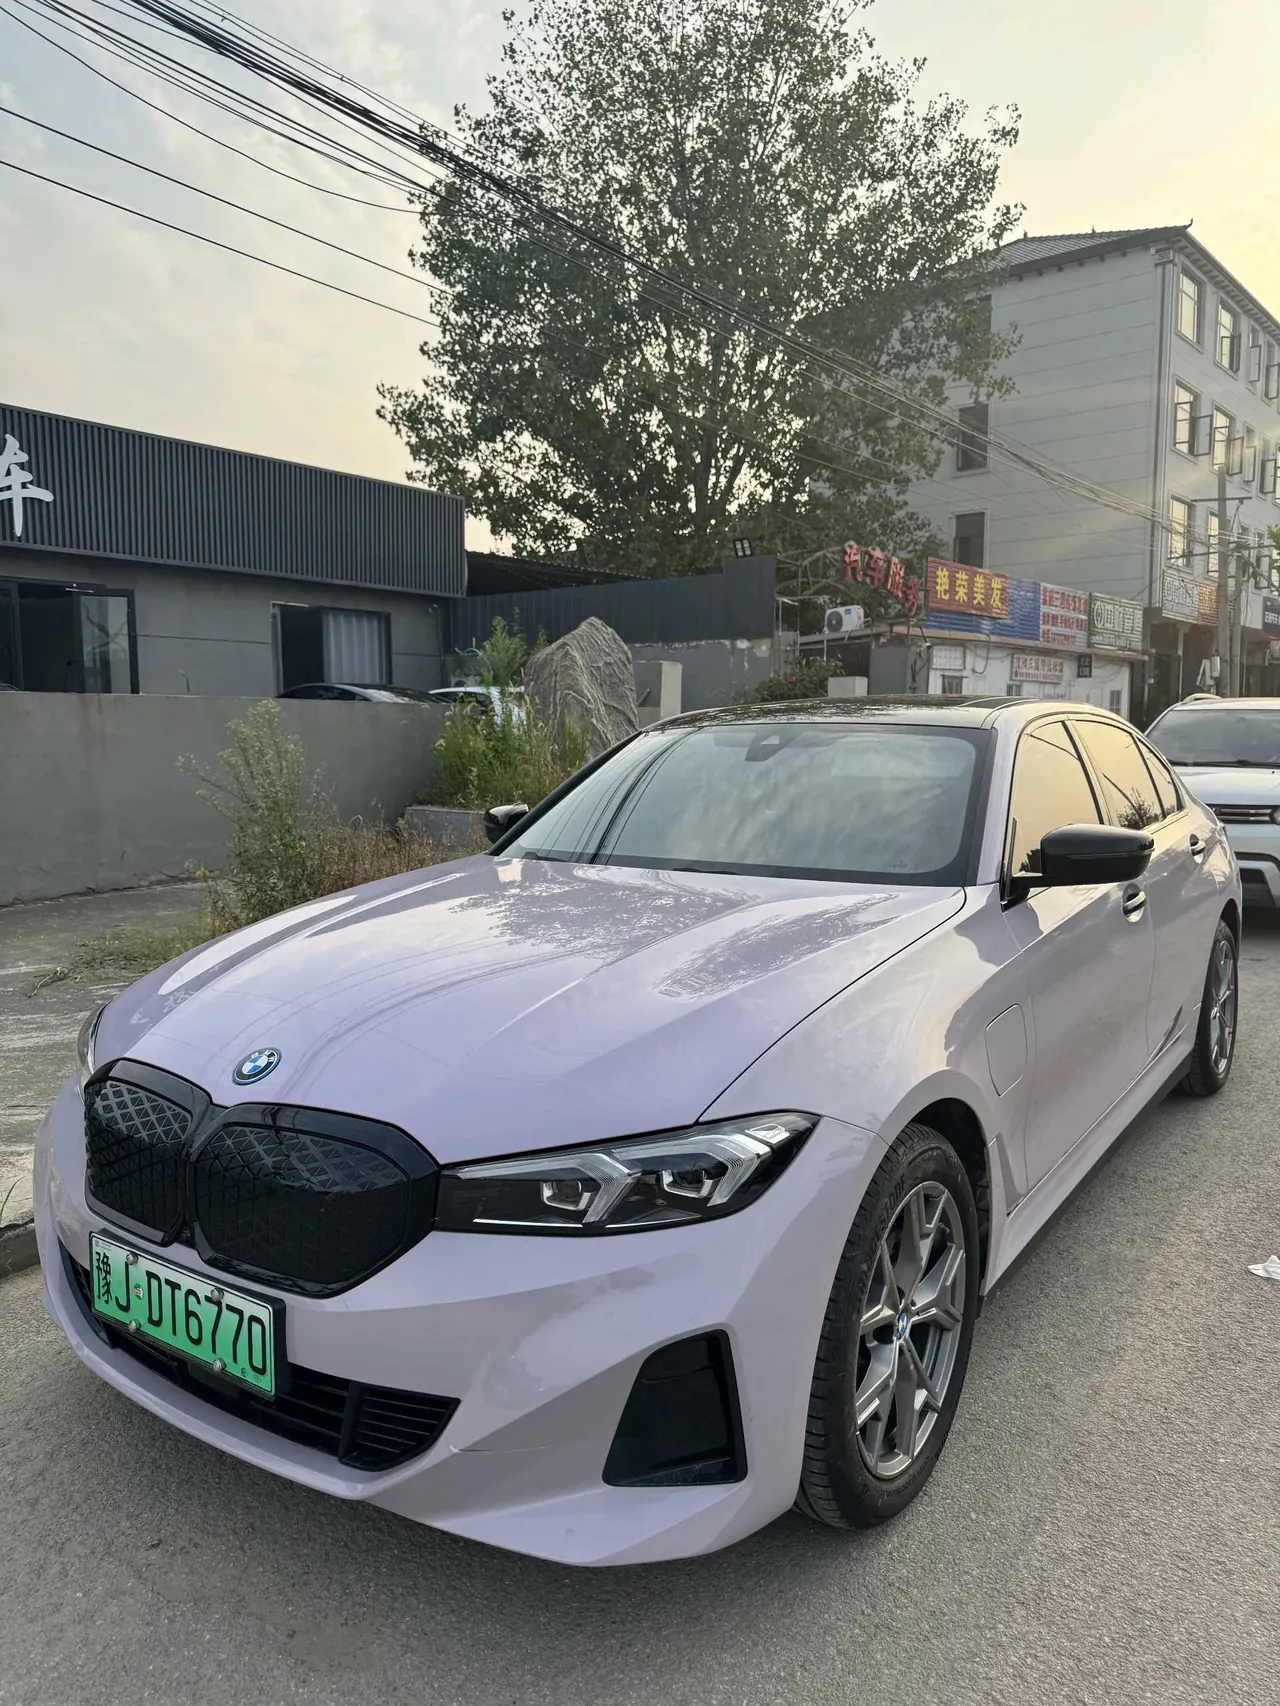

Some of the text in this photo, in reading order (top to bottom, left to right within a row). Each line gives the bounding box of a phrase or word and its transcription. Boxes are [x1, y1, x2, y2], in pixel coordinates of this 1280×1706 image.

[0, 433, 54, 537] 车
[843, 539, 919, 617] 汽车服务
[935, 566, 1002, 609] 艳荣美发
[145, 1269, 267, 1376] DT6770
